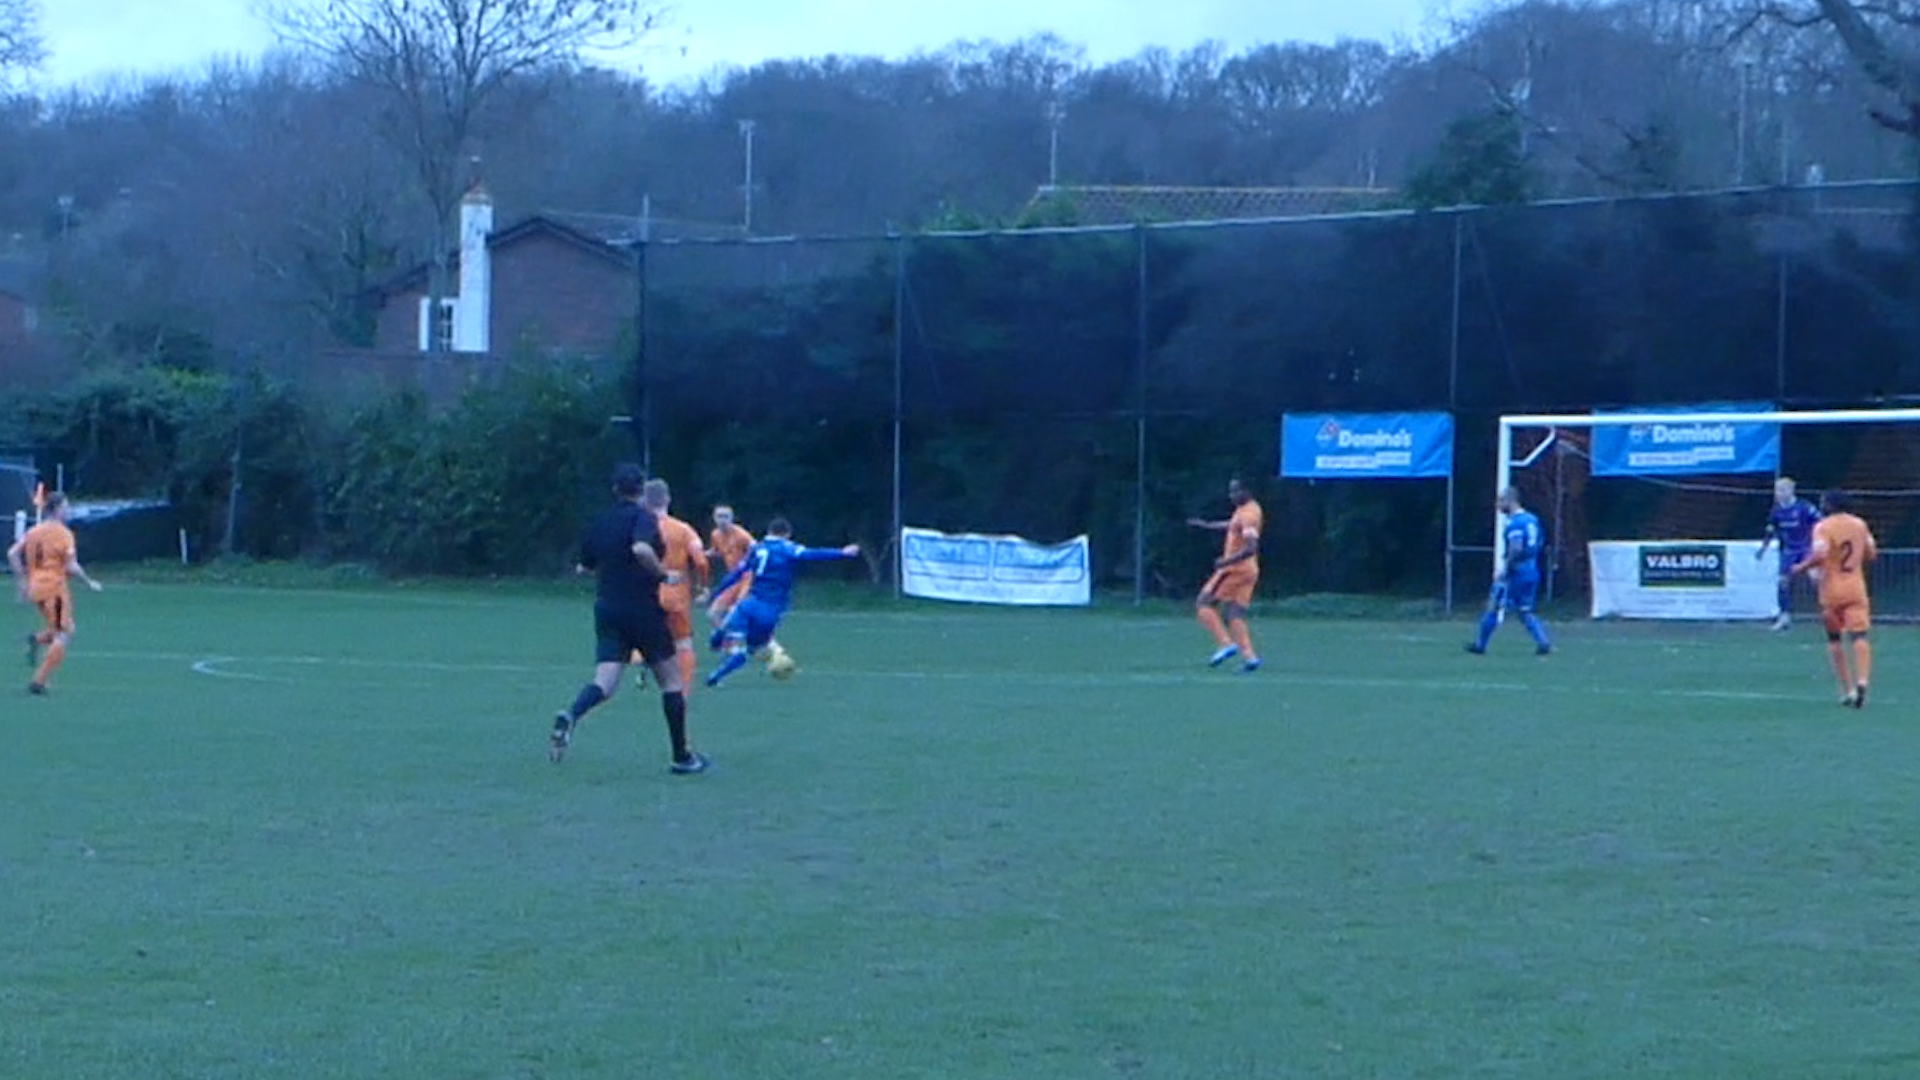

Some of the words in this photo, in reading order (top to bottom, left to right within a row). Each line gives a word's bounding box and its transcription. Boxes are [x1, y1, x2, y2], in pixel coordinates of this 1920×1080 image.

[756, 549, 769, 576] 7
[1646, 554, 1719, 568] VALBRO
[1840, 541, 1853, 572] 2
